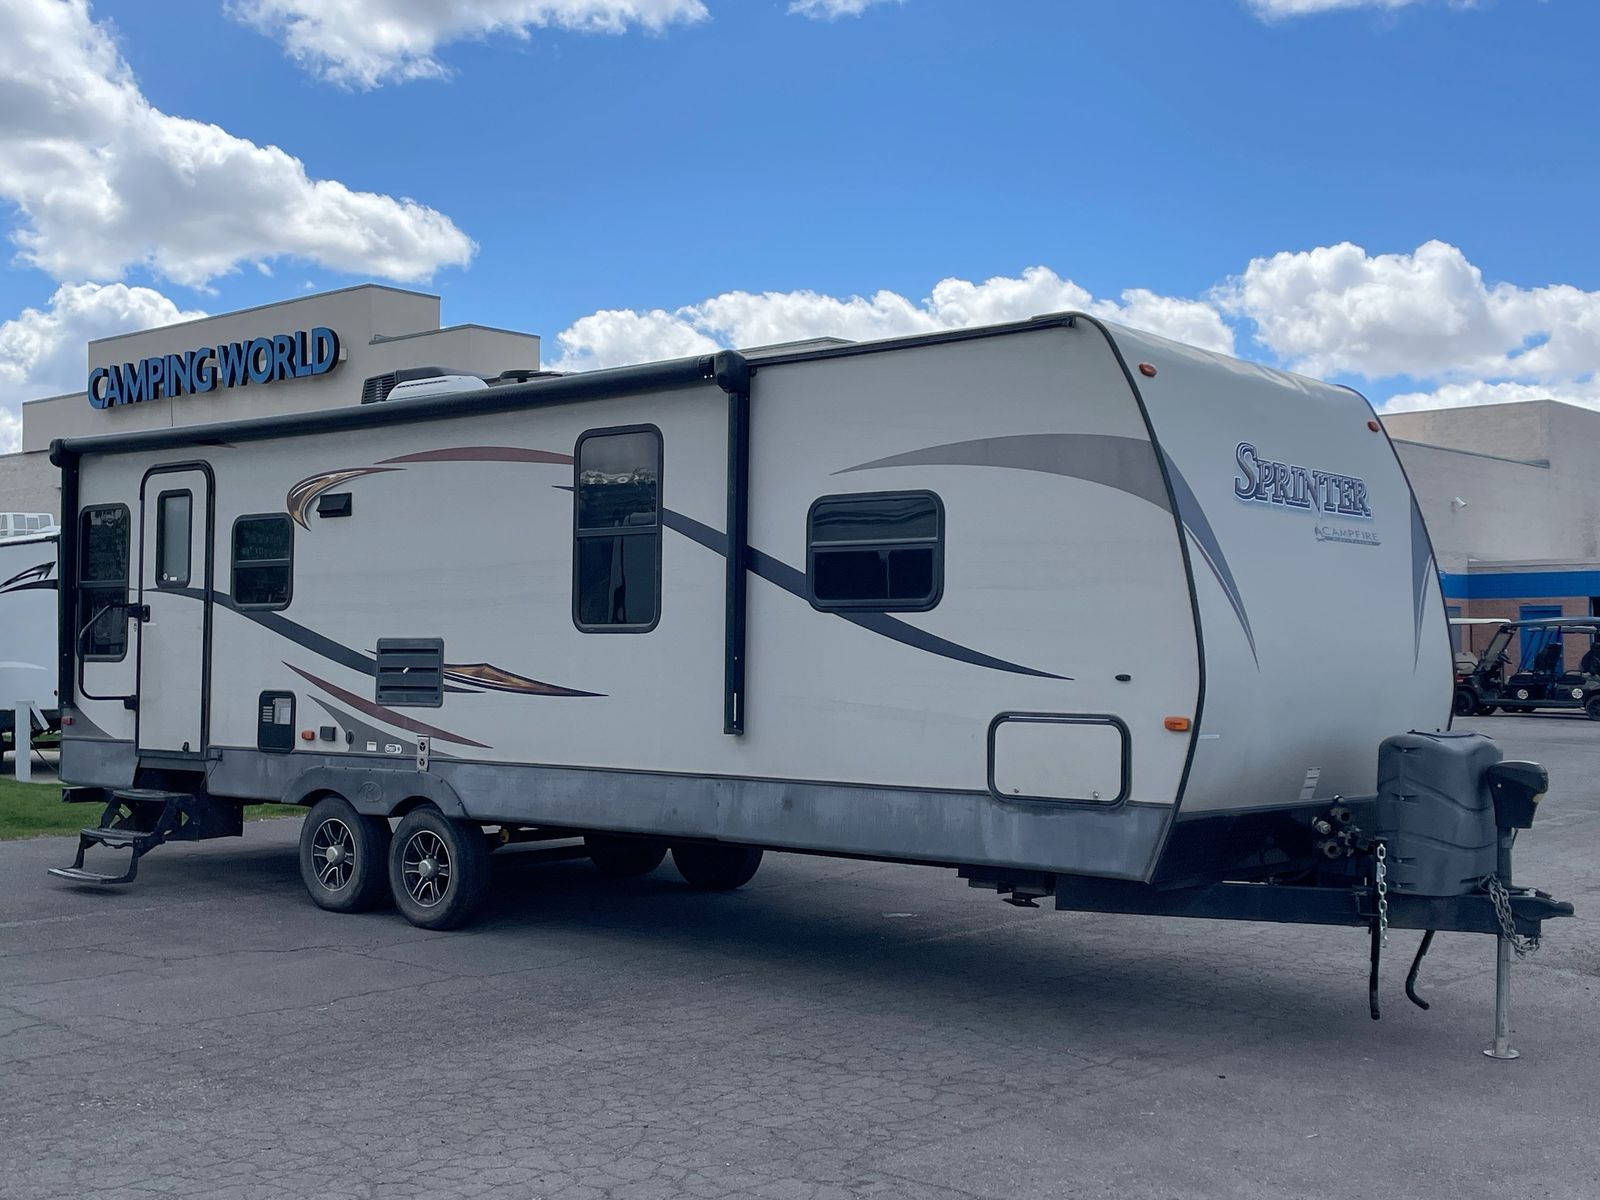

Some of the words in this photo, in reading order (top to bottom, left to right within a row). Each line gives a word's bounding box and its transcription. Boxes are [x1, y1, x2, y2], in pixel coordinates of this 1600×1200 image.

[88, 347, 216, 409] CAMPING
[217, 327, 340, 388] WORLD
[1321, 526, 1379, 541] CAMPFIRE
